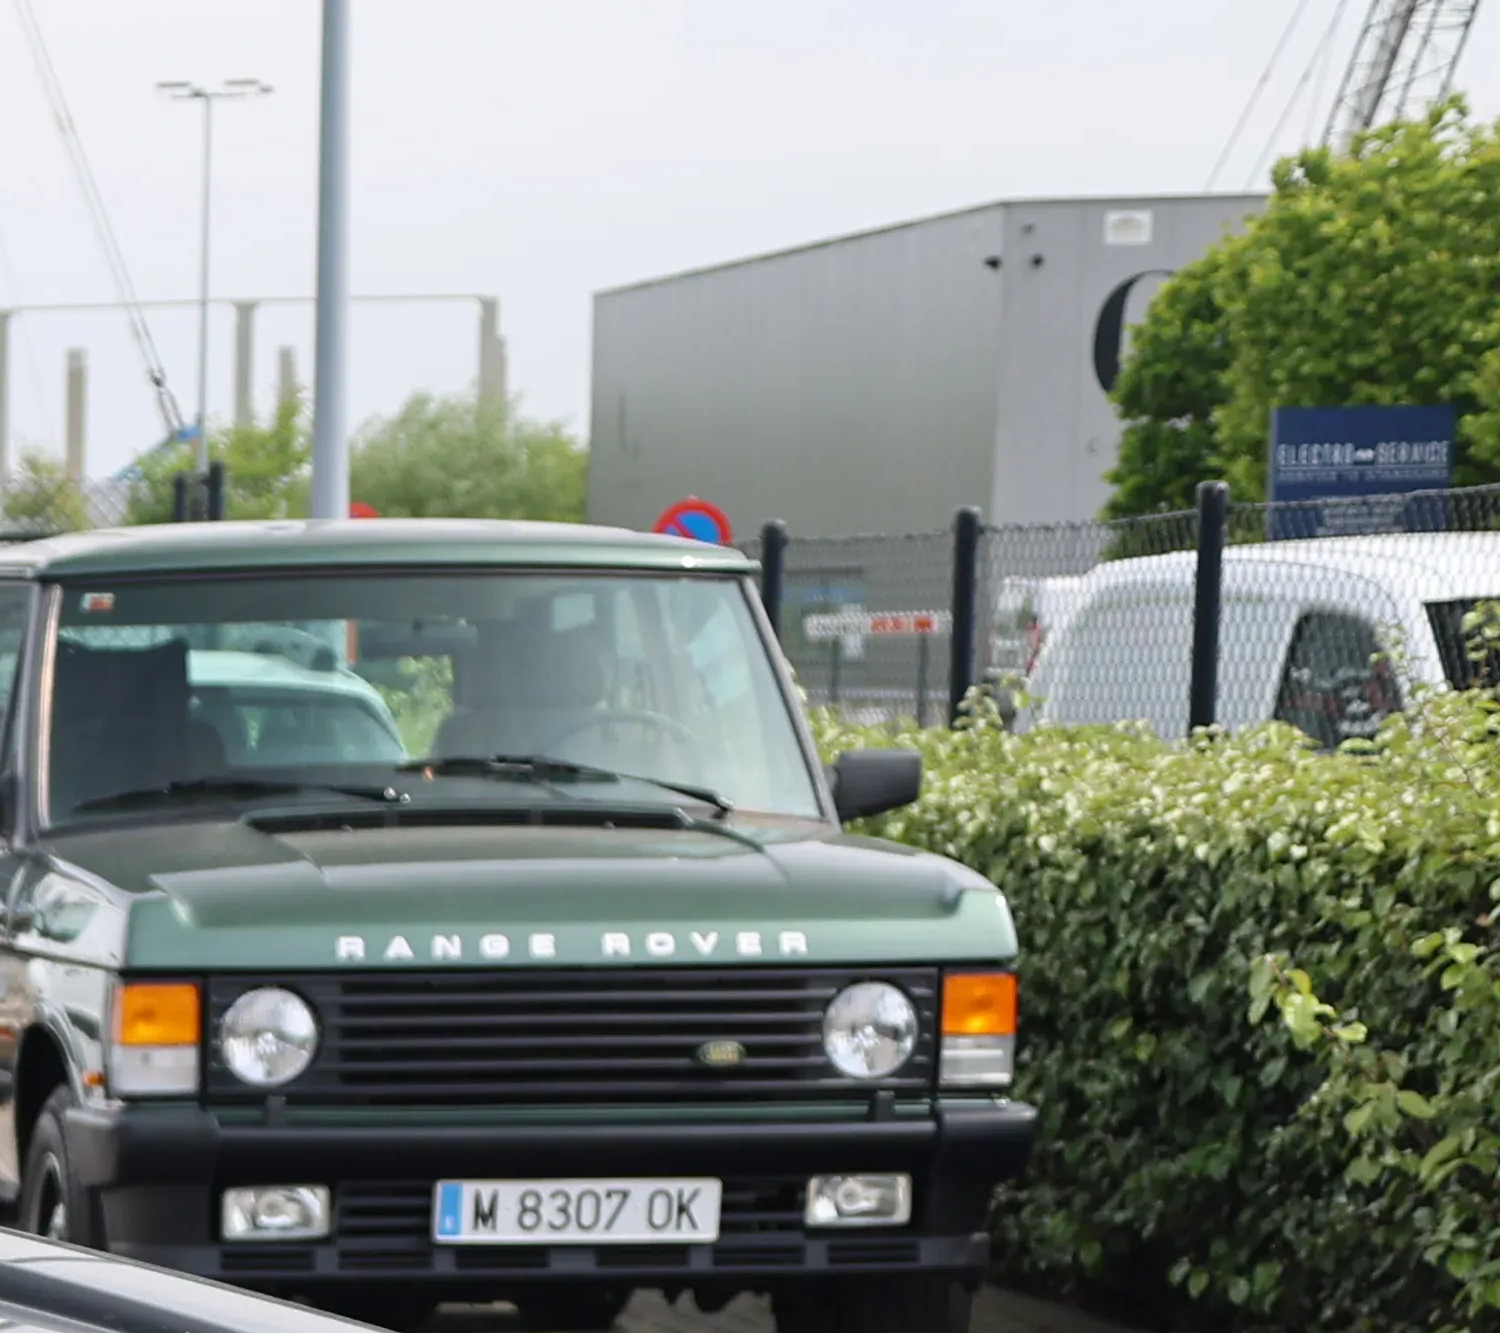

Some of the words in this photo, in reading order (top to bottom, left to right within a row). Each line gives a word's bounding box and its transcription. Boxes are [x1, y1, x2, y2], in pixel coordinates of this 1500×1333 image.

[335, 932, 556, 960] RANGE
[600, 930, 809, 956] ROVER
[472, 1188, 499, 1231] M
[517, 1189, 631, 1231] 8307
